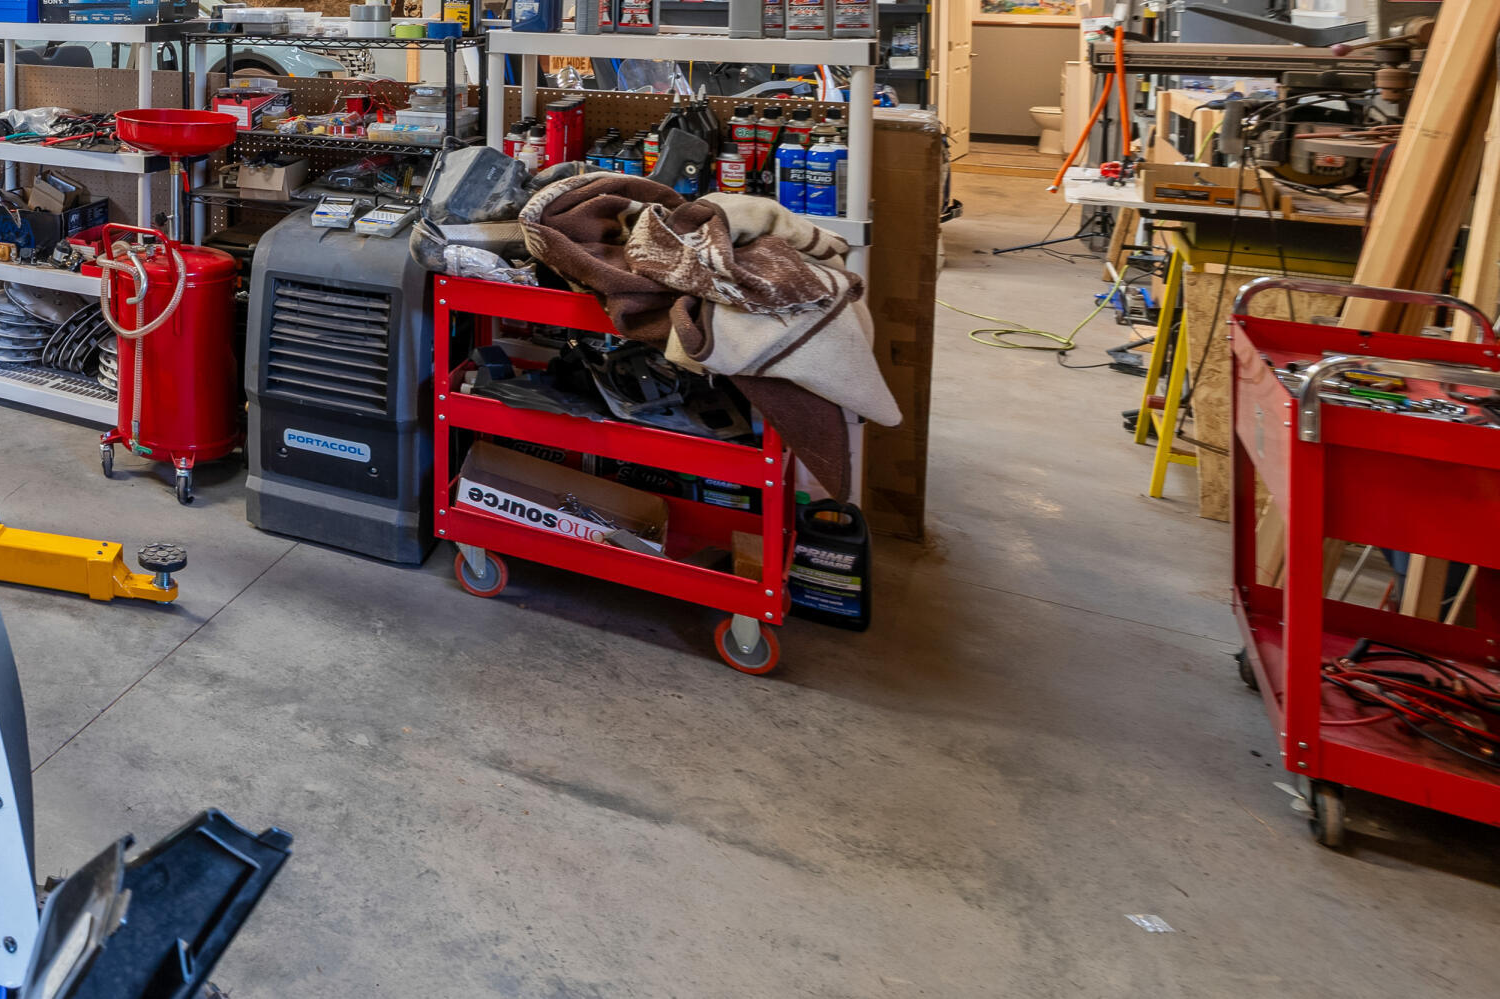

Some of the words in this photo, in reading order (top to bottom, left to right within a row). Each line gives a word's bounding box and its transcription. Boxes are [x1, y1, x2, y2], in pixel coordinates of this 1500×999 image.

[287, 433, 365, 456] PORTACOOL
[795, 544, 857, 564] PRIME
[810, 557, 852, 571] GUARD
